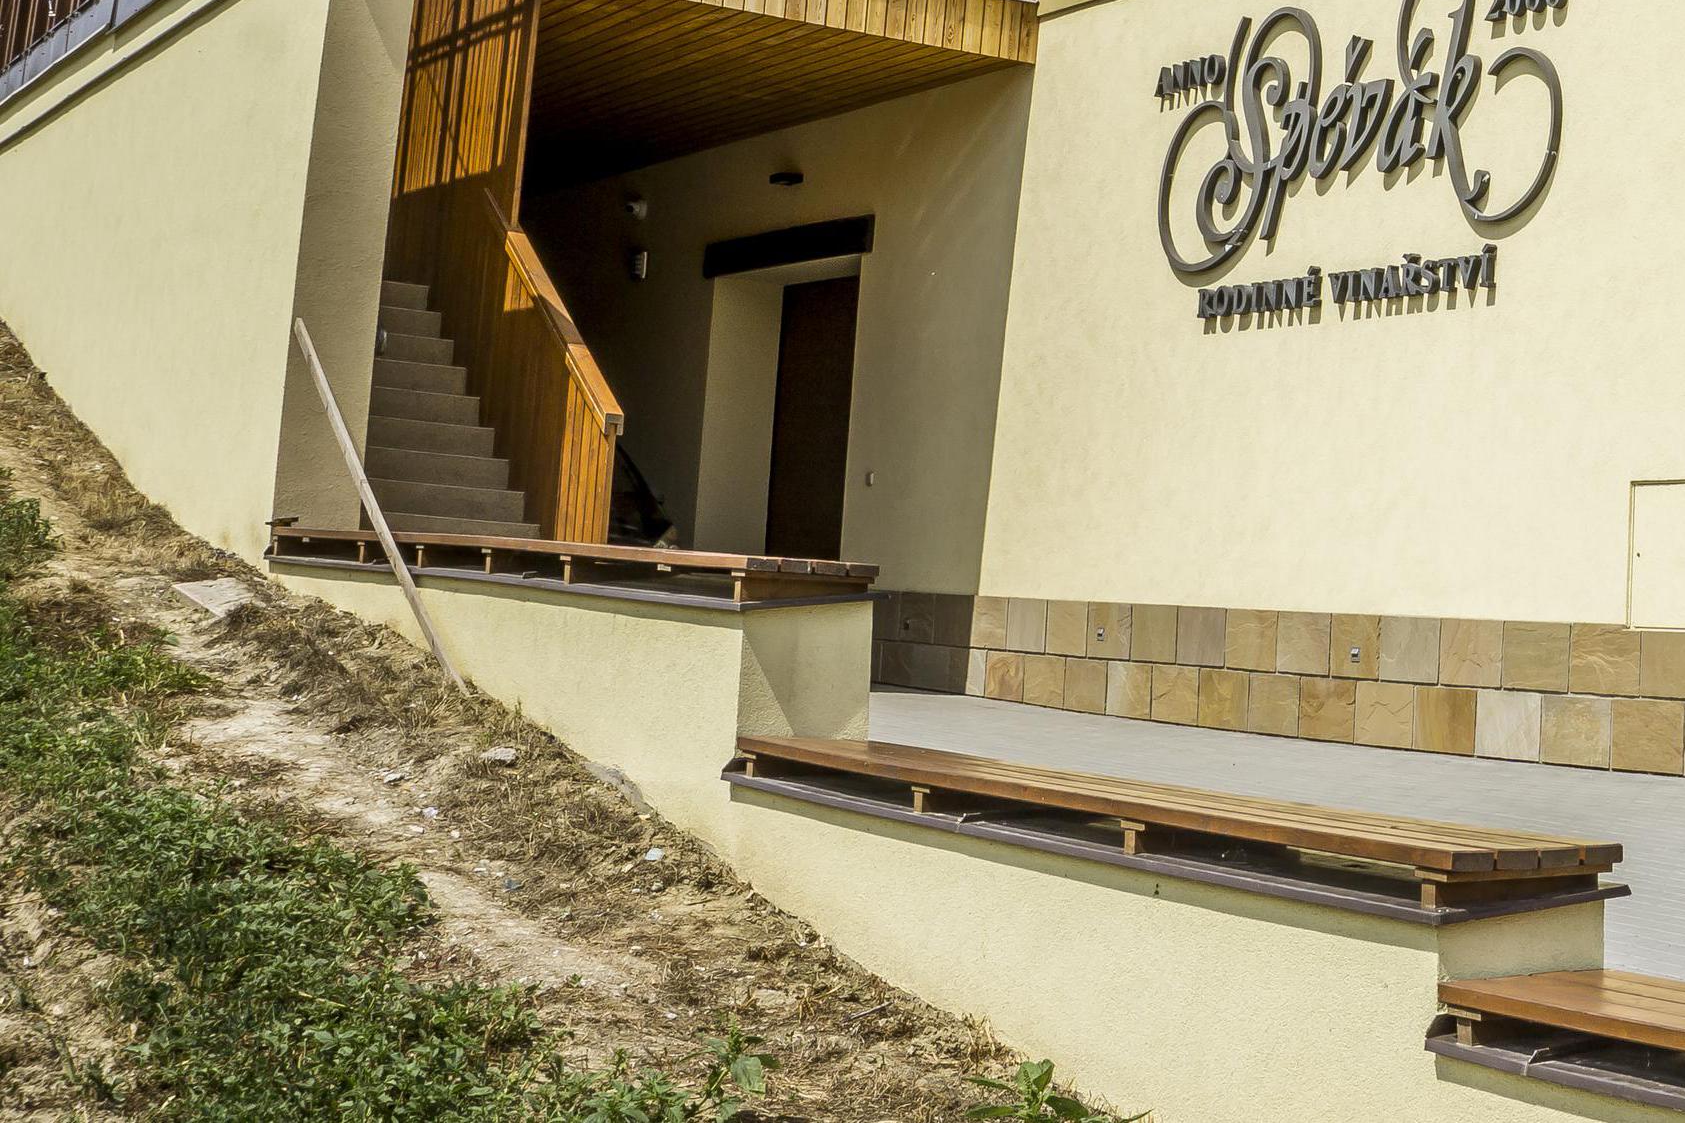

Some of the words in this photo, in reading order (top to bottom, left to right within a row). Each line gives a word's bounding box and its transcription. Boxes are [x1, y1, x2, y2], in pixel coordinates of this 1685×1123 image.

[1154, 54, 1226, 98] ANNO
[1197, 266, 1322, 319] RODINNÉ
[1328, 244, 1498, 306] VINAŘSTVÍ
